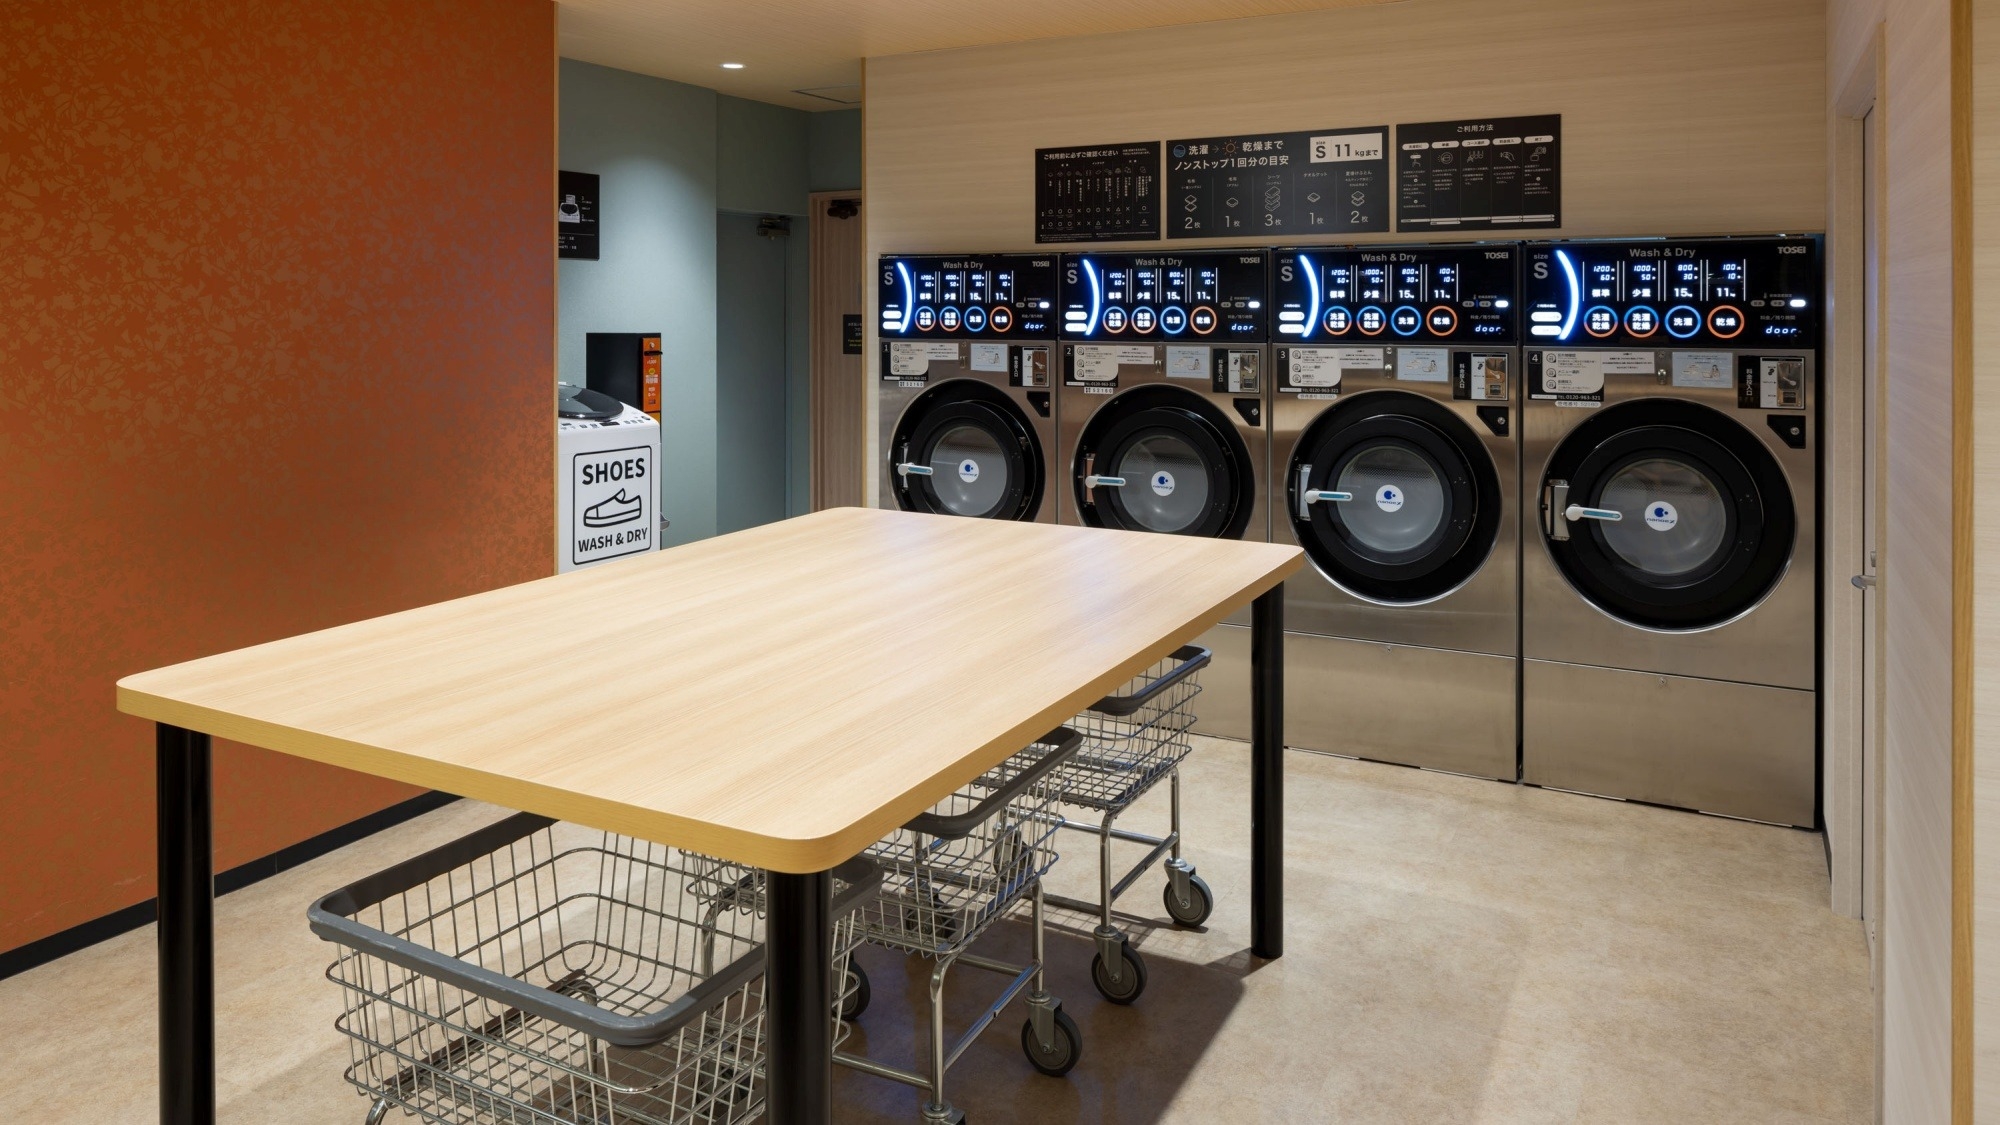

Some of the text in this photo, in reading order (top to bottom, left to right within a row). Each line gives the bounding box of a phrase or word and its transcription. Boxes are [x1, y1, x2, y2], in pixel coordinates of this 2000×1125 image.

[1457, 124, 1493, 132] ご利用方法
[1189, 140, 1284, 155] 洗濯 乾燥まで
[1316, 145, 1326, 159] S
[1335, 144, 1350, 157] 11
[1044, 150, 1118, 160] ご利用前に必ずご確認ください
[1174, 155, 1289, 170] ノンストップ1回分の目安
[1630, 248, 1695, 259] Wash & Dry
[1778, 246, 1805, 254] TOSEI
[1136, 258, 1182, 267] Wash & Dry
[1361, 253, 1416, 263] Wash & Dry
[1281, 266, 1293, 281] S
[1534, 262, 1548, 280] S
[884, 272, 893, 285] S
[1067, 270, 1077, 284] S
[1641, 273, 1656, 281] 50
[1364, 290, 1379, 298] 少量
[1592, 289, 1610, 297] 標準
[1632, 288, 1651, 297] 少量
[1674, 288, 1693, 298] 15kg
[1716, 288, 1736, 298] 11kg
[1398, 317, 1414, 325] 洗濯
[1434, 317, 1450, 325] 乾燥
[1592, 313, 1610, 322] 洗濯
[1632, 313, 1650, 322] 洗濯
[1674, 318, 1692, 326] 洗濯
[1716, 318, 1735, 326] 乾燥
[1592, 322, 1610, 330] 乾燥
[1632, 322, 1650, 330] 乾燥
[1766, 326, 1796, 335] door
[1280, 351, 1285, 359] 3
[1532, 354, 1538, 362] 4
[582, 458, 645, 485] SHOES
[578, 527, 648, 552] WASH & DRY
